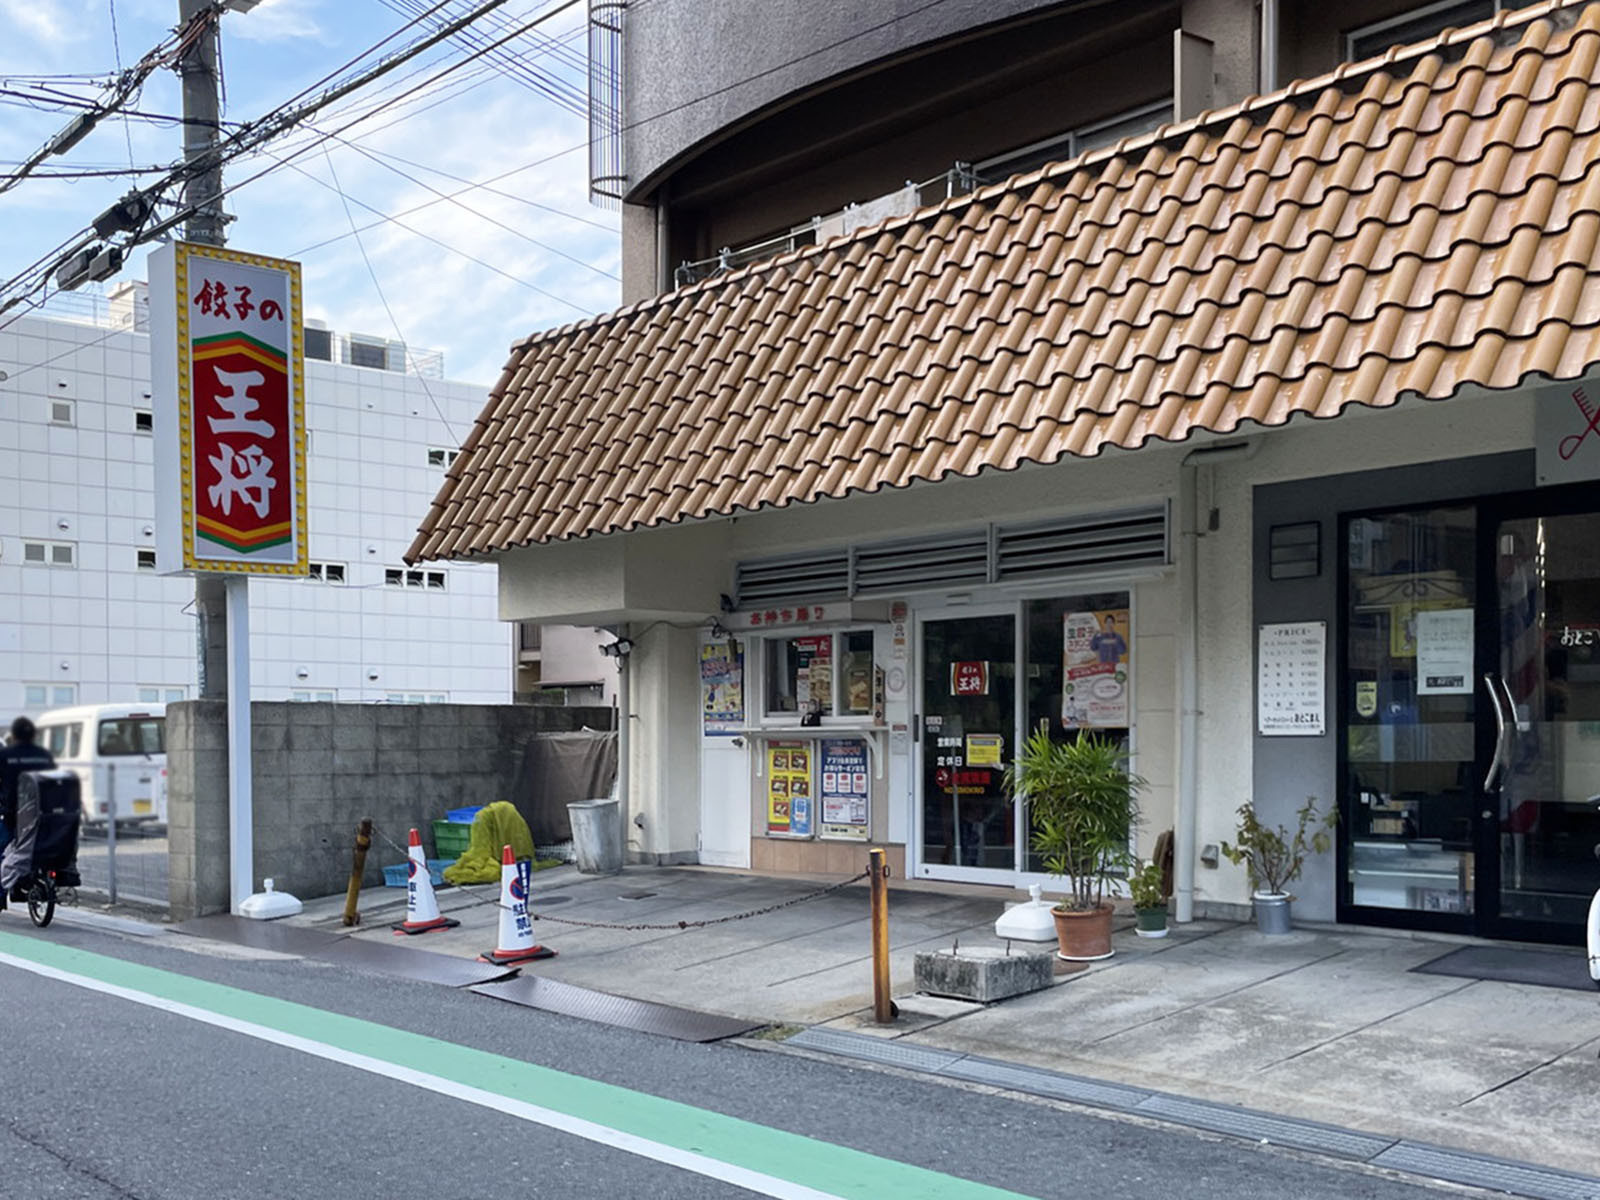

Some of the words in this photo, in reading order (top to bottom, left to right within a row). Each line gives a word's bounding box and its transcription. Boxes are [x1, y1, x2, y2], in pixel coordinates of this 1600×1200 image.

[194, 279, 284, 322] 餃子の
[207, 365, 276, 519] 王将
[750, 606, 825, 626] お持ち帰り
[959, 677, 981, 690] 王将
[937, 737, 963, 748] 営業時間
[937, 756, 963, 767] 定休日
